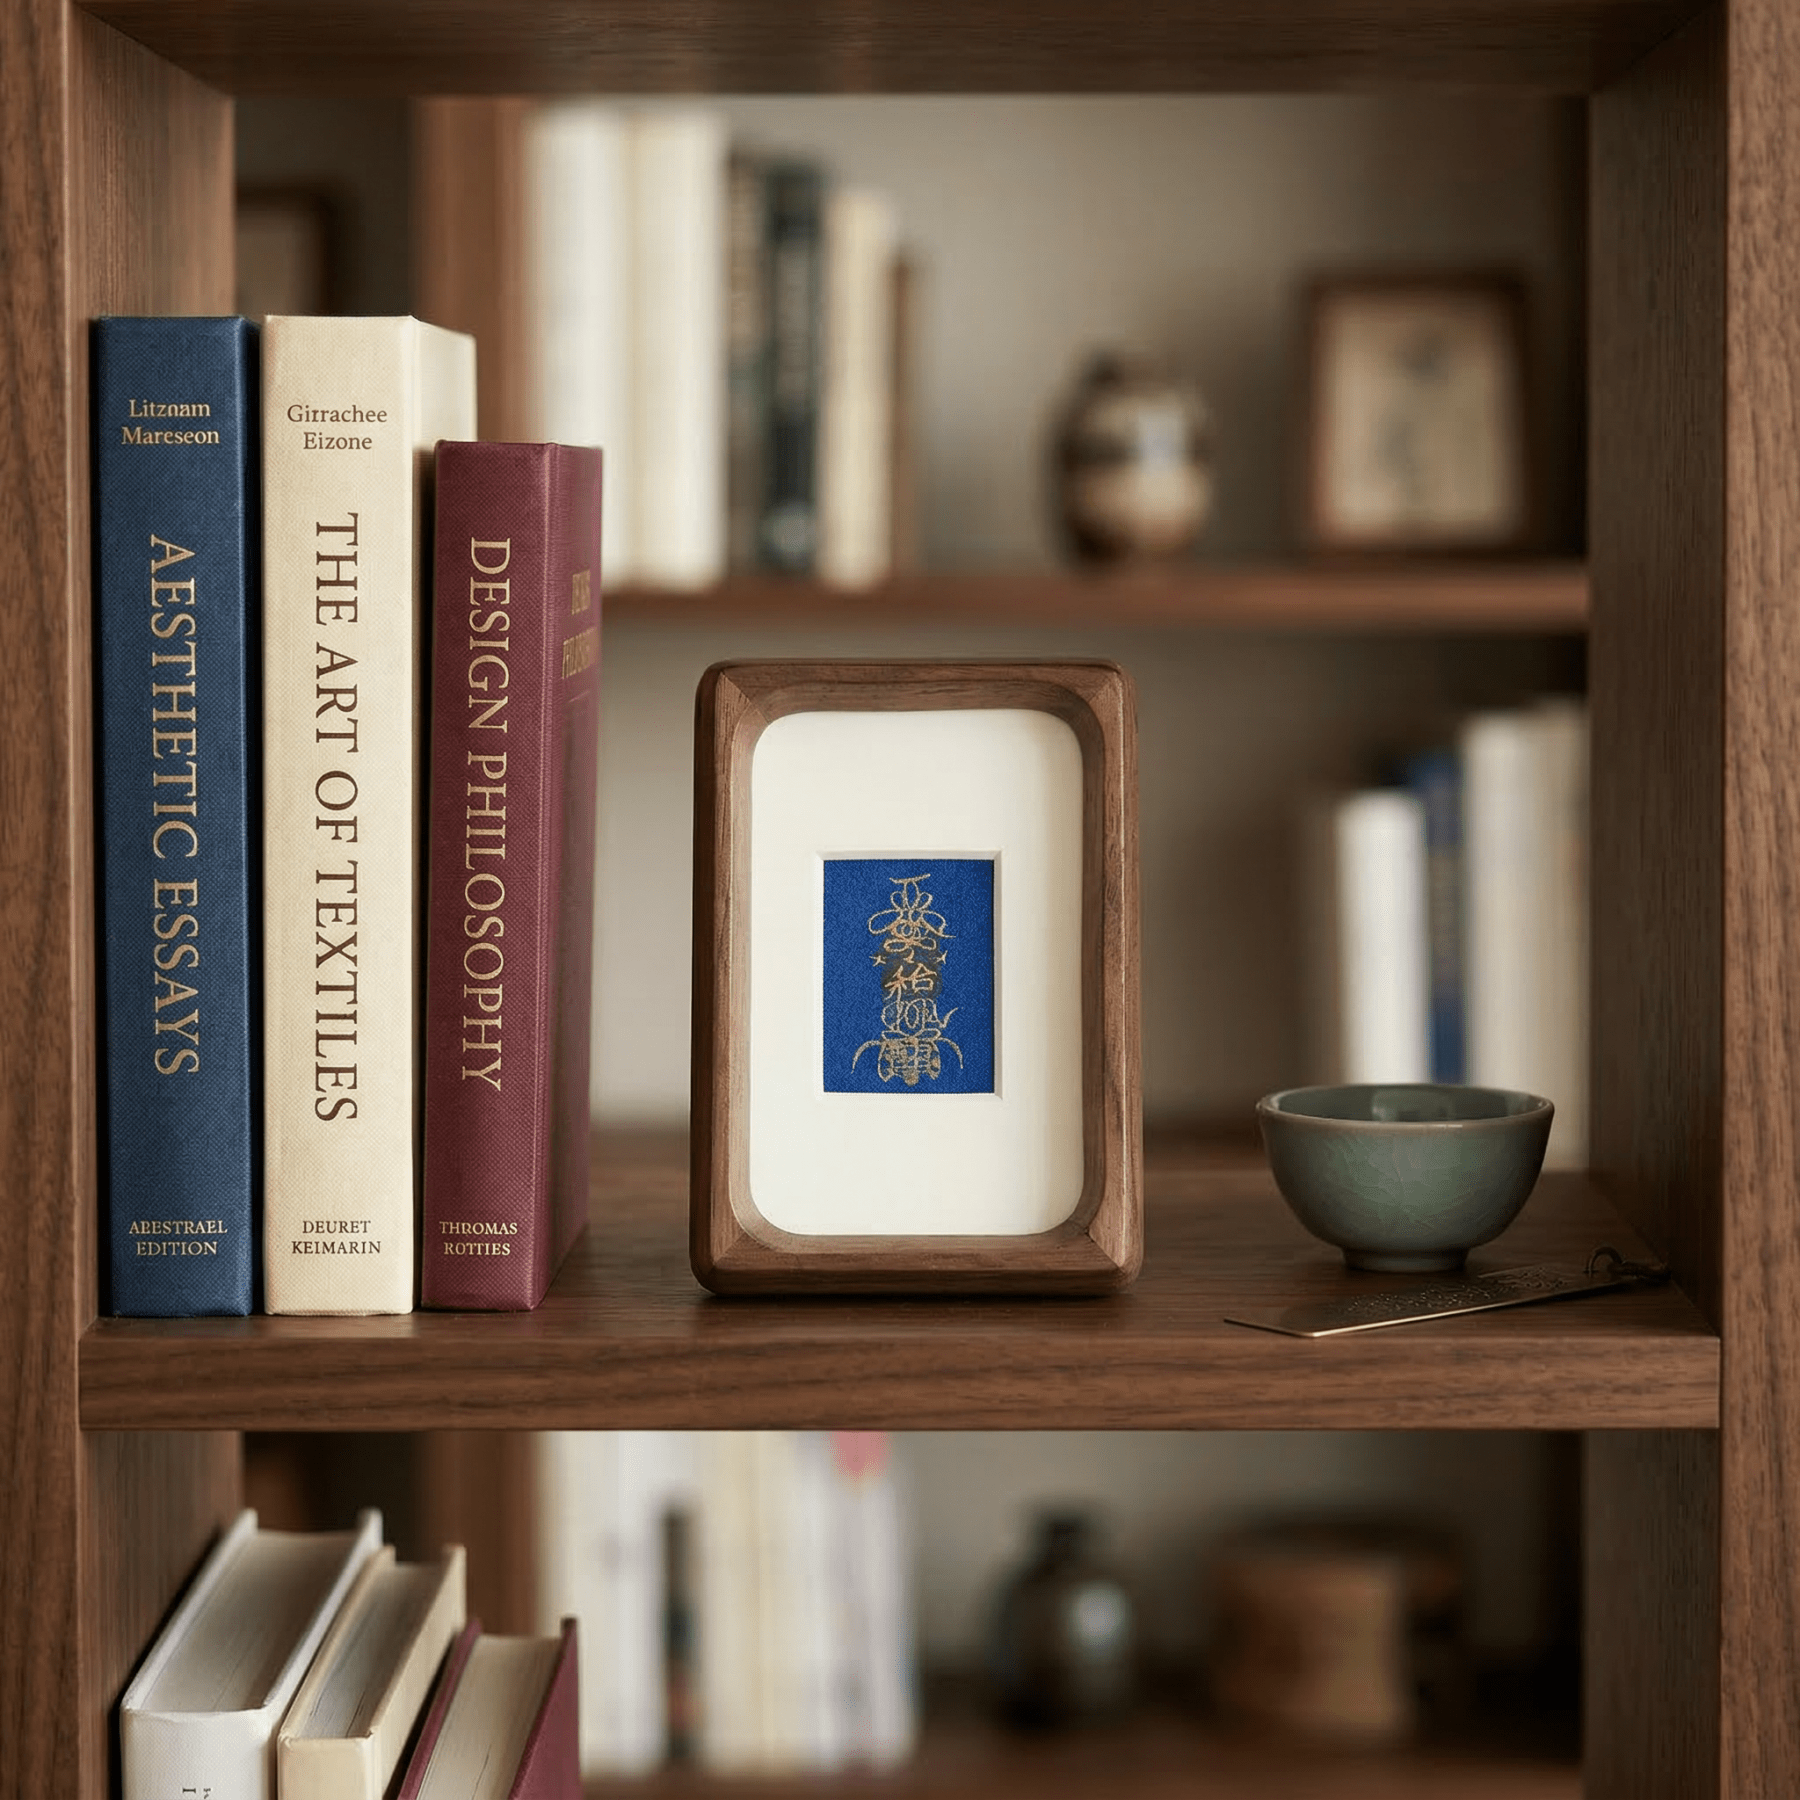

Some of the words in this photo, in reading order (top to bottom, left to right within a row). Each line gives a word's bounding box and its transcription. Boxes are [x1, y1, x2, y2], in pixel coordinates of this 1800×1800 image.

[121, 426, 220, 445] Mareseon
[129, 399, 211, 417] Litznam
[287, 404, 388, 423] Girrachee
[303, 431, 373, 450] Eizone
[315, 512, 359, 626] THE
[467, 537, 512, 733] DESIGN
[149, 534, 199, 860] AESTHETIC
[315, 642, 359, 753] ART
[315, 770, 359, 843] OF
[461, 751, 508, 1092] PHILOSOPHY
[153, 878, 200, 1075] ESSAYS
[314, 860, 359, 1122] TEXTILES
[136, 1241, 218, 1256] EDITION
[291, 1241, 381, 1254] KEIMARIN
[302, 1220, 372, 1234] DEURET
